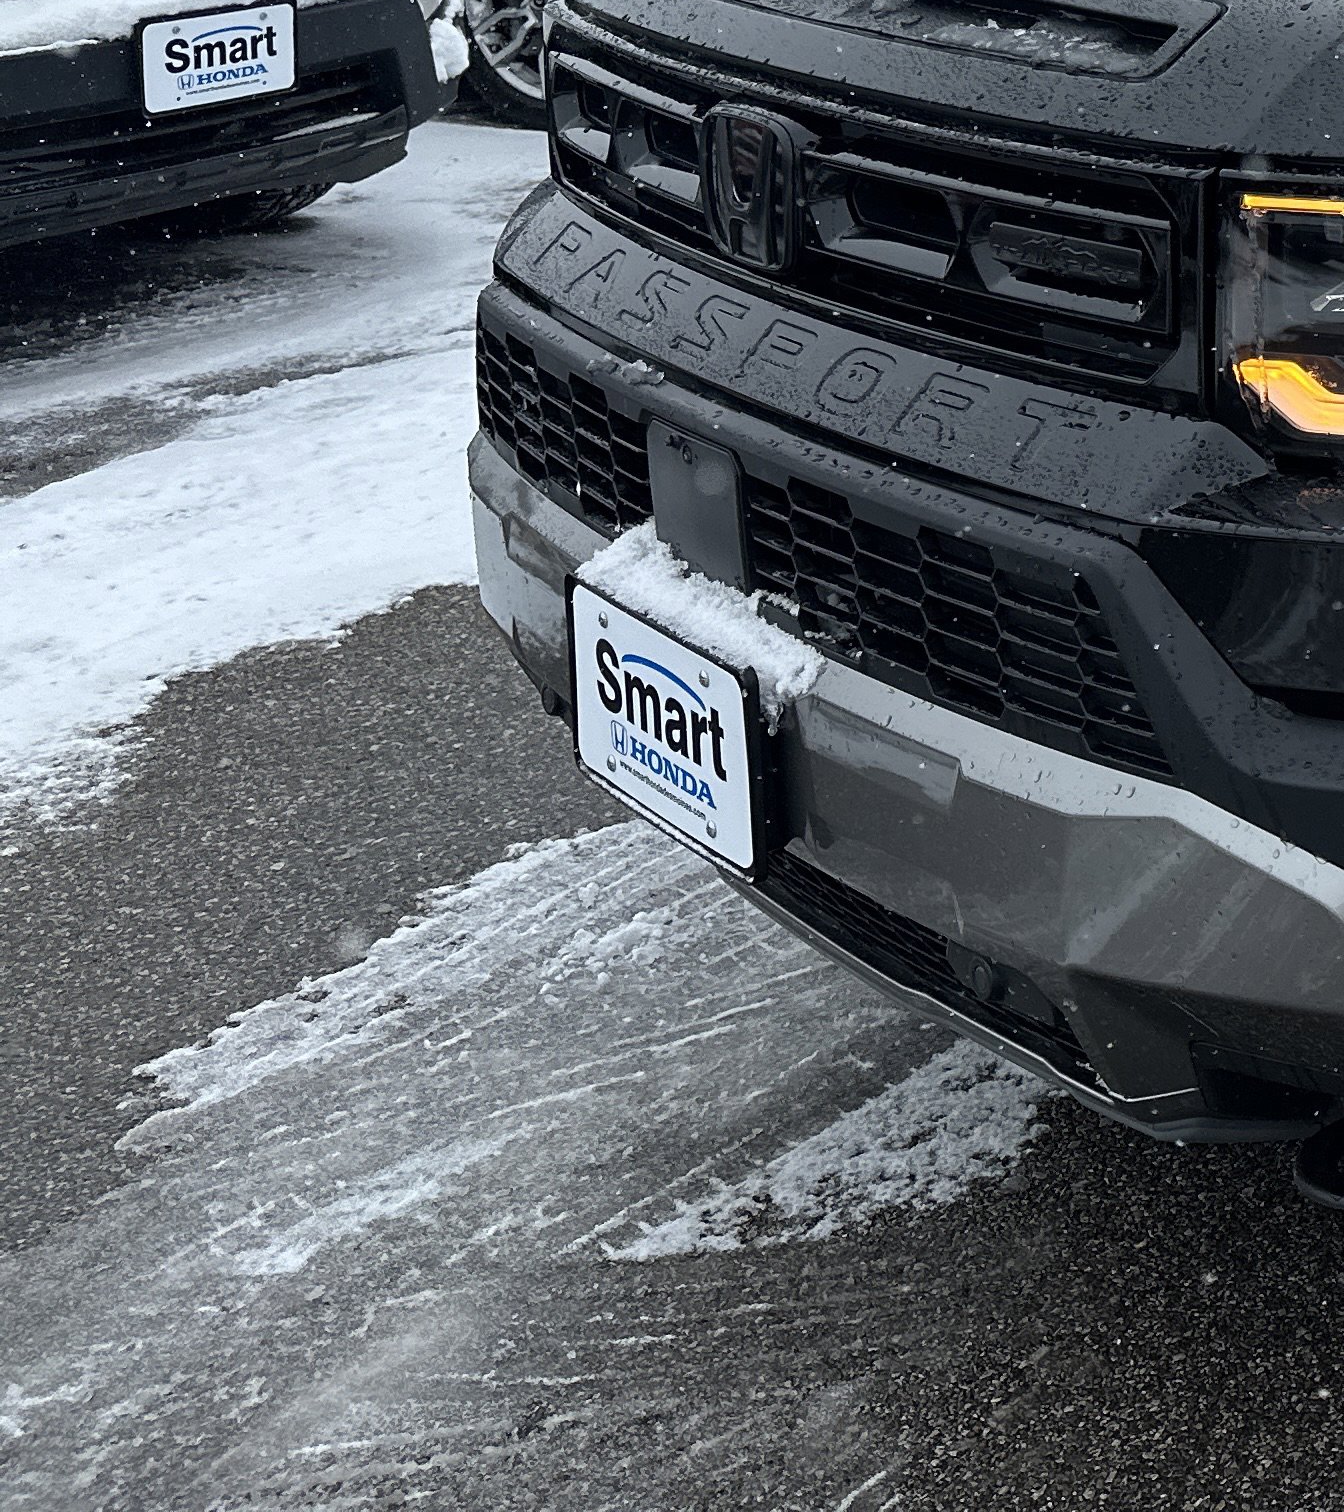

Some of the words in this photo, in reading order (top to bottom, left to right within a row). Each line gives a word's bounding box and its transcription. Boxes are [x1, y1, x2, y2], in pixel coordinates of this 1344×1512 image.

[165, 26, 277, 74] Smart
[197, 64, 268, 86] HONDA
[530, 220, 1098, 472] PASSPORT
[595, 638, 727, 782] Smart
[630, 736, 717, 810] HONDA
